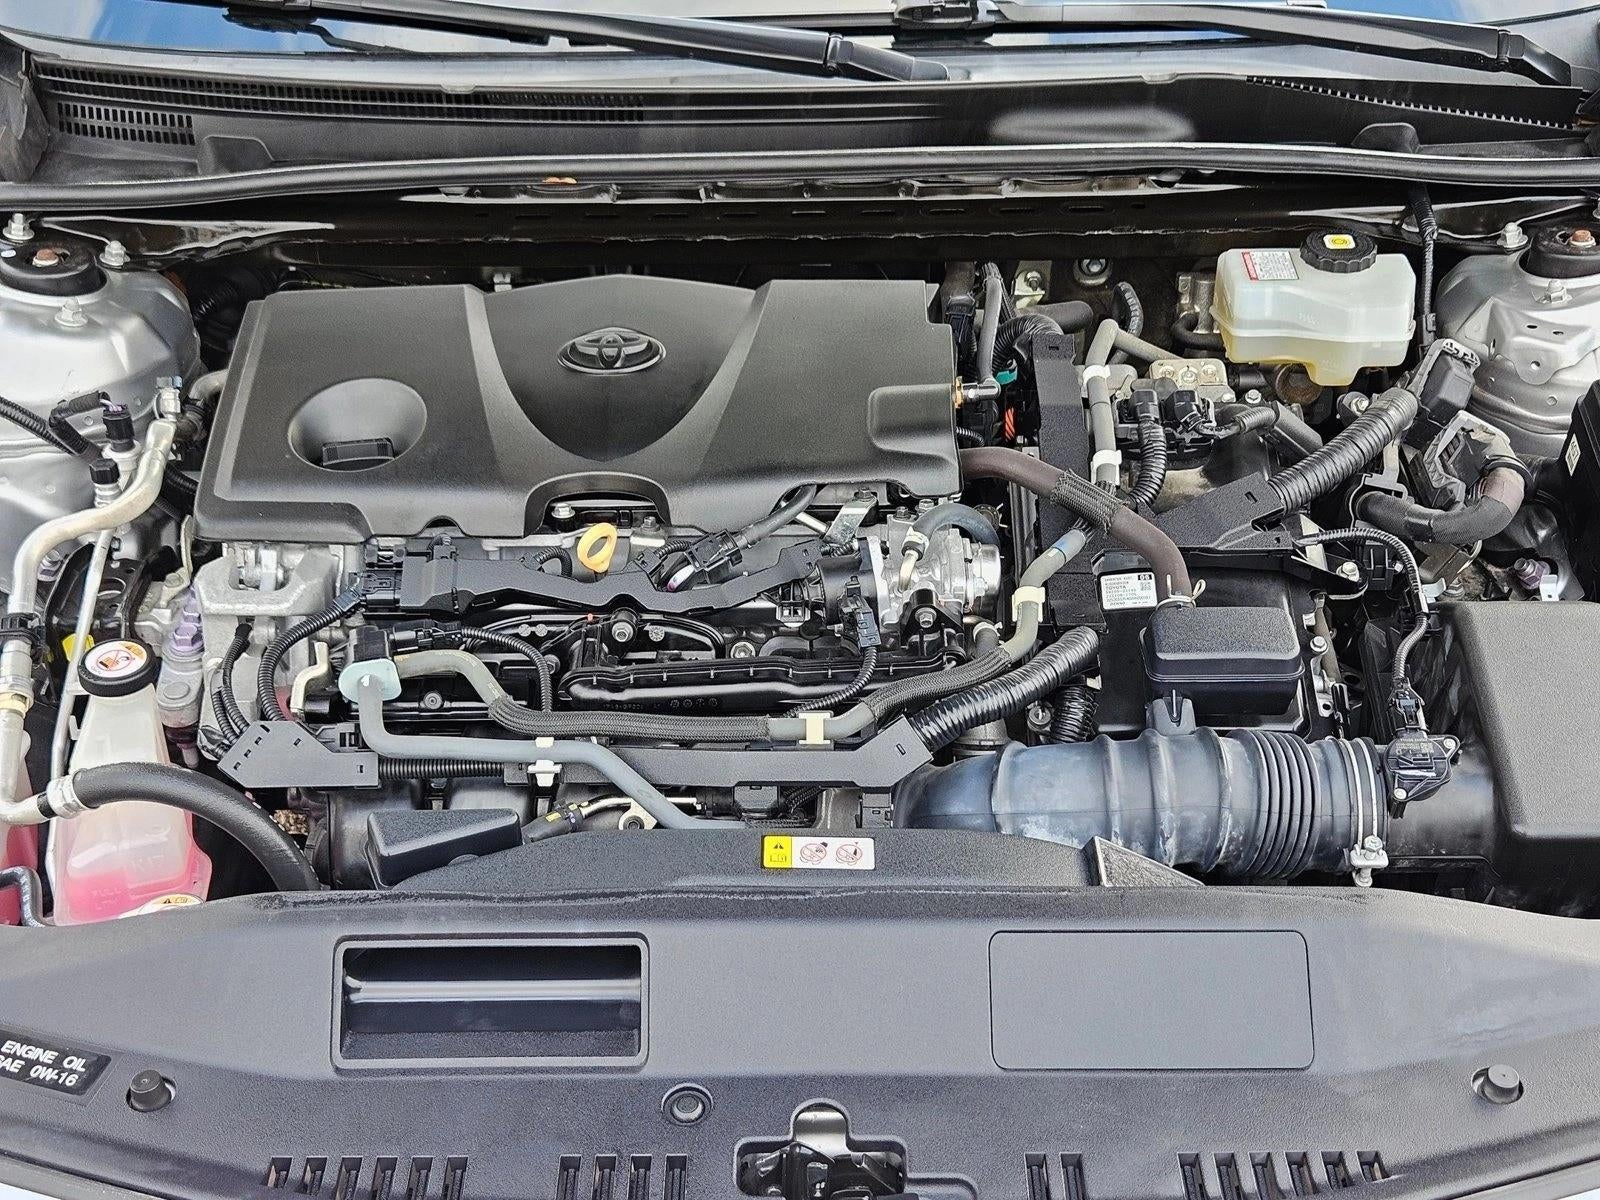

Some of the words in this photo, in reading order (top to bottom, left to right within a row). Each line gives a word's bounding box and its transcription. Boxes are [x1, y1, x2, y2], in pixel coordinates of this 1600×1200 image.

[1, 1040, 59, 1064] ENGINE
[62, 1056, 87, 1072] OIL
[29, 1065, 79, 1087] 0W-16
